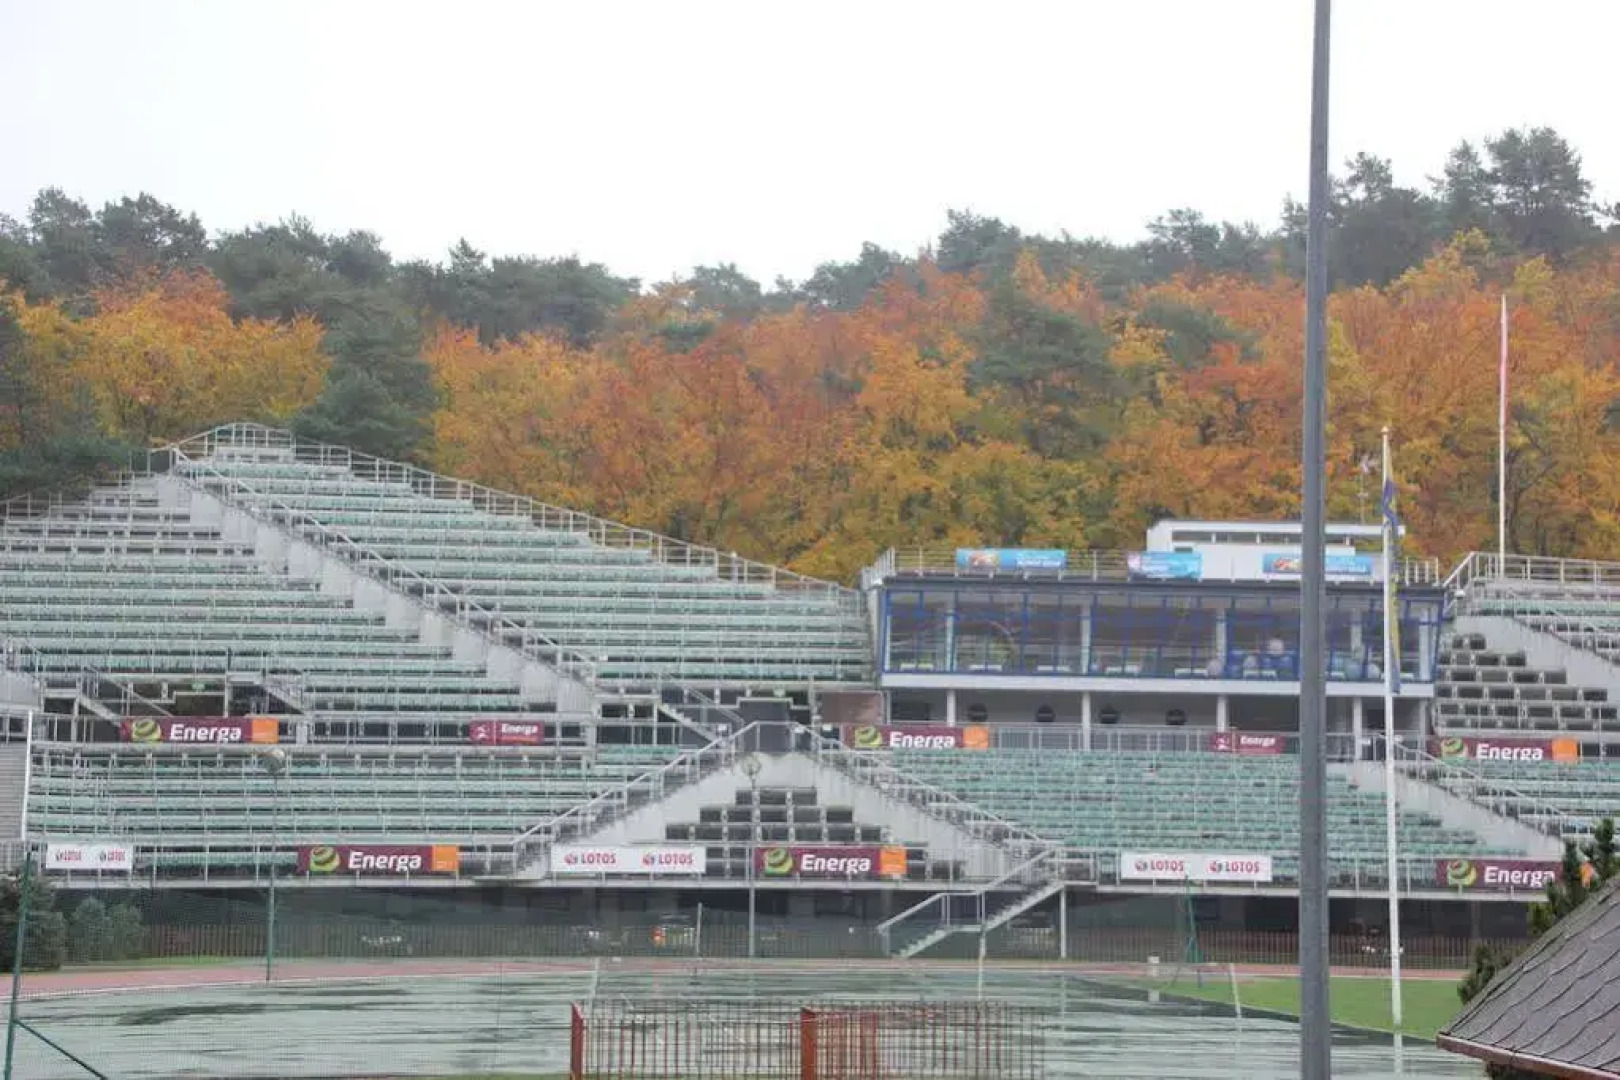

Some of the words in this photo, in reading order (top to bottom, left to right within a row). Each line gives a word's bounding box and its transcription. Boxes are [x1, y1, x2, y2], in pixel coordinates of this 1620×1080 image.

[170, 723, 242, 744] Energa
[501, 722, 538, 735] Energa
[890, 732, 955, 750] Energa
[1476, 743, 1543, 762] Energa
[348, 851, 421, 872] Energa
[580, 853, 616, 865] LOTOS
[658, 853, 694, 865] LOTOS
[801, 855, 871, 874] Energa
[1150, 860, 1185, 872] LOTOS
[1225, 860, 1260, 872] LOTOS
[1483, 866, 1555, 887] Energa
